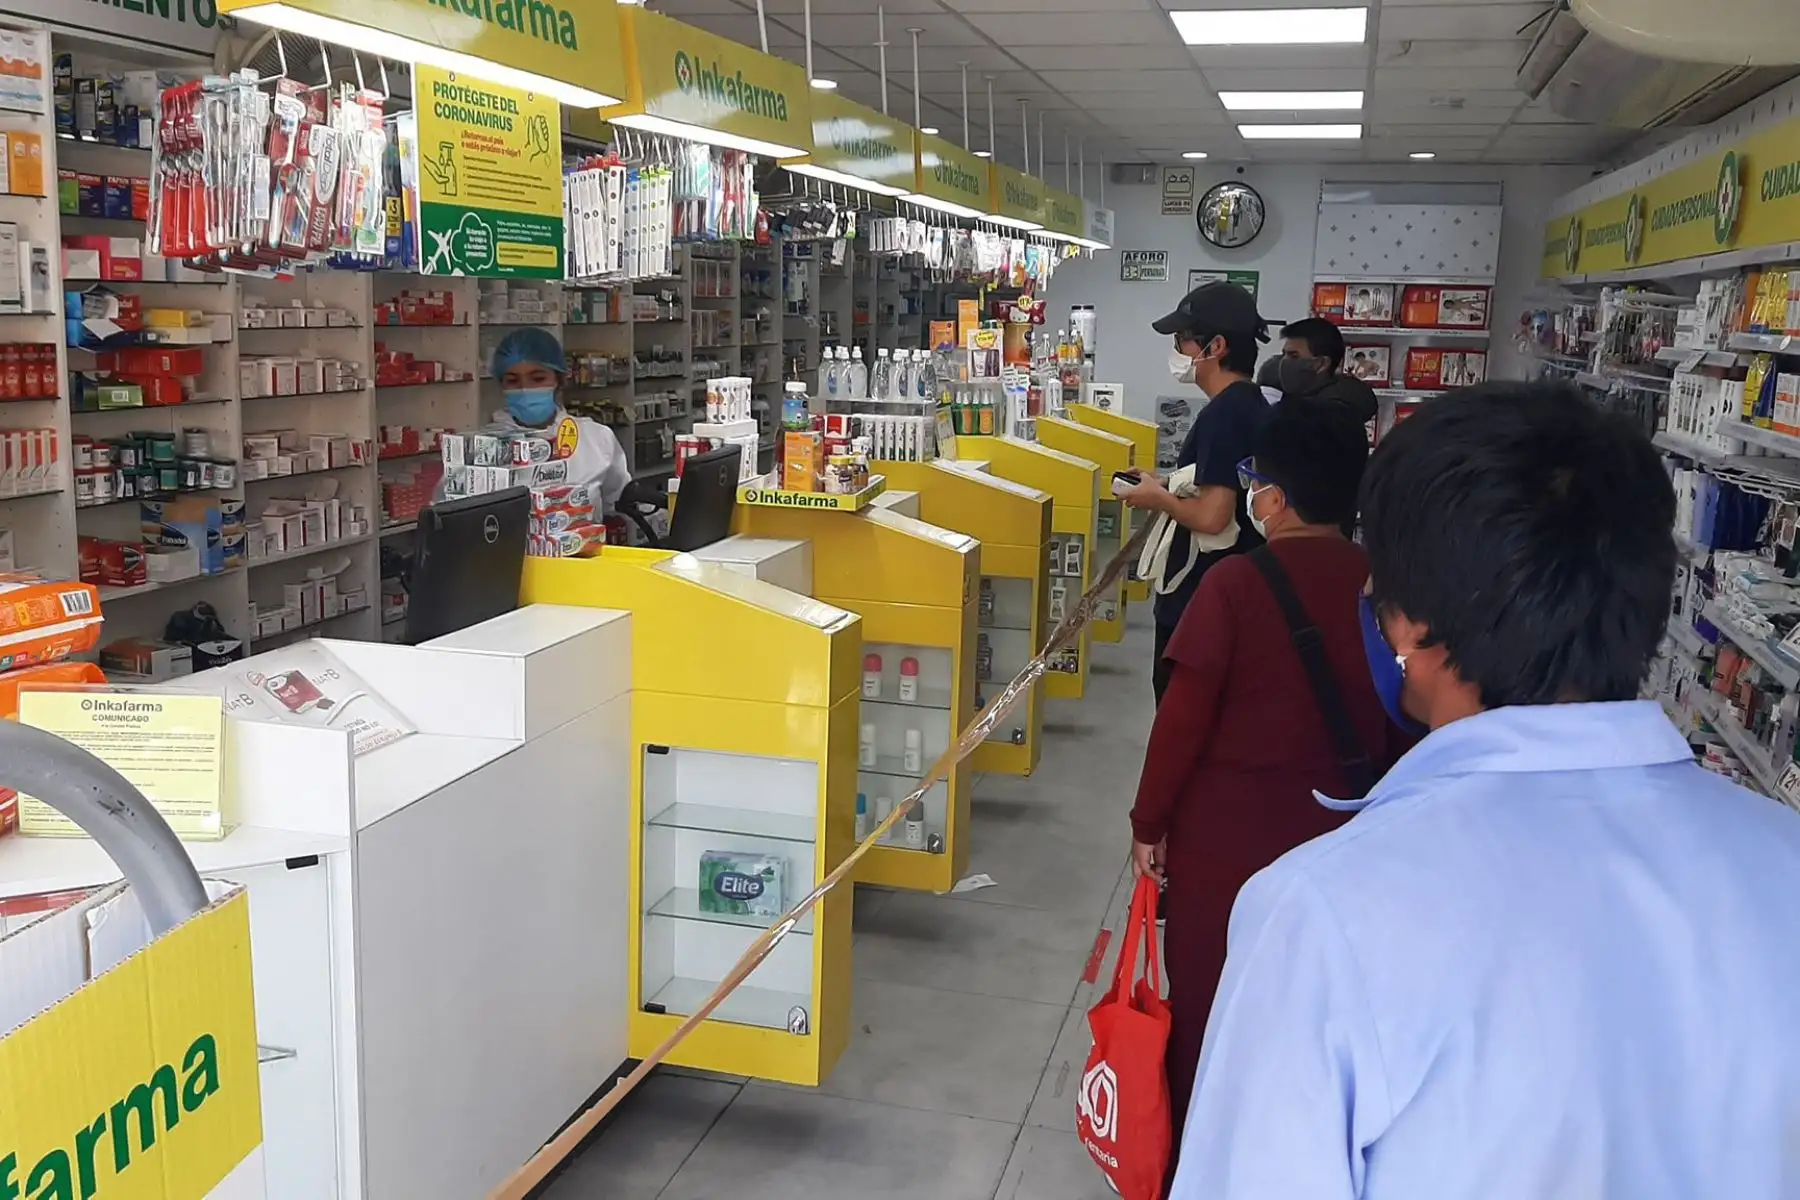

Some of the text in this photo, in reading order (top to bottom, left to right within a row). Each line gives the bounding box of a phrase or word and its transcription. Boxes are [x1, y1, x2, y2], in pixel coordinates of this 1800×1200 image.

[433, 80, 520, 115] PROTÉGETE DEL
[694, 56, 788, 122] Inkafarma
[434, 101, 514, 132] CORONAVIRUS
[1124, 252, 1165, 261] AFORO
[759, 490, 838, 508] Inkafarma
[94, 699, 163, 713] Inkafarma
[92, 713, 150, 723] COMUNICADO
[721, 876, 760, 894] Elite
